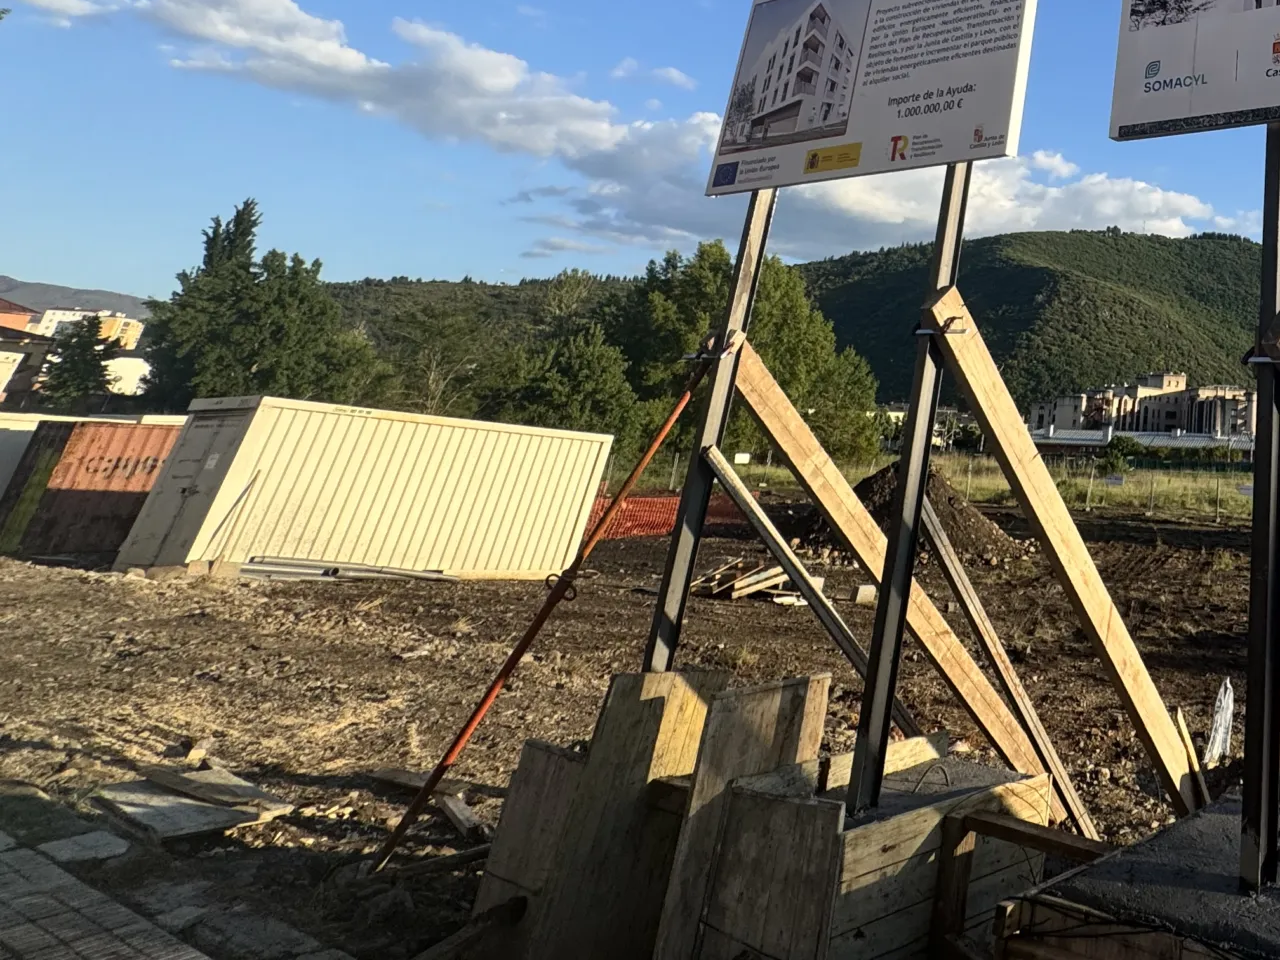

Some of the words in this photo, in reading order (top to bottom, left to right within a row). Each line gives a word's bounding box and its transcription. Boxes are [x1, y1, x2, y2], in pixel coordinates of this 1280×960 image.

[1144, 74, 1207, 93] SOMACYL
[888, 93, 920, 107] Importe
[923, 90, 934, 100] de
[936, 88, 944, 98] la
[945, 82, 977, 98] Ayuda:
[897, 100, 955, 119] 1.000.000,00
[957, 98, 964, 108] €
